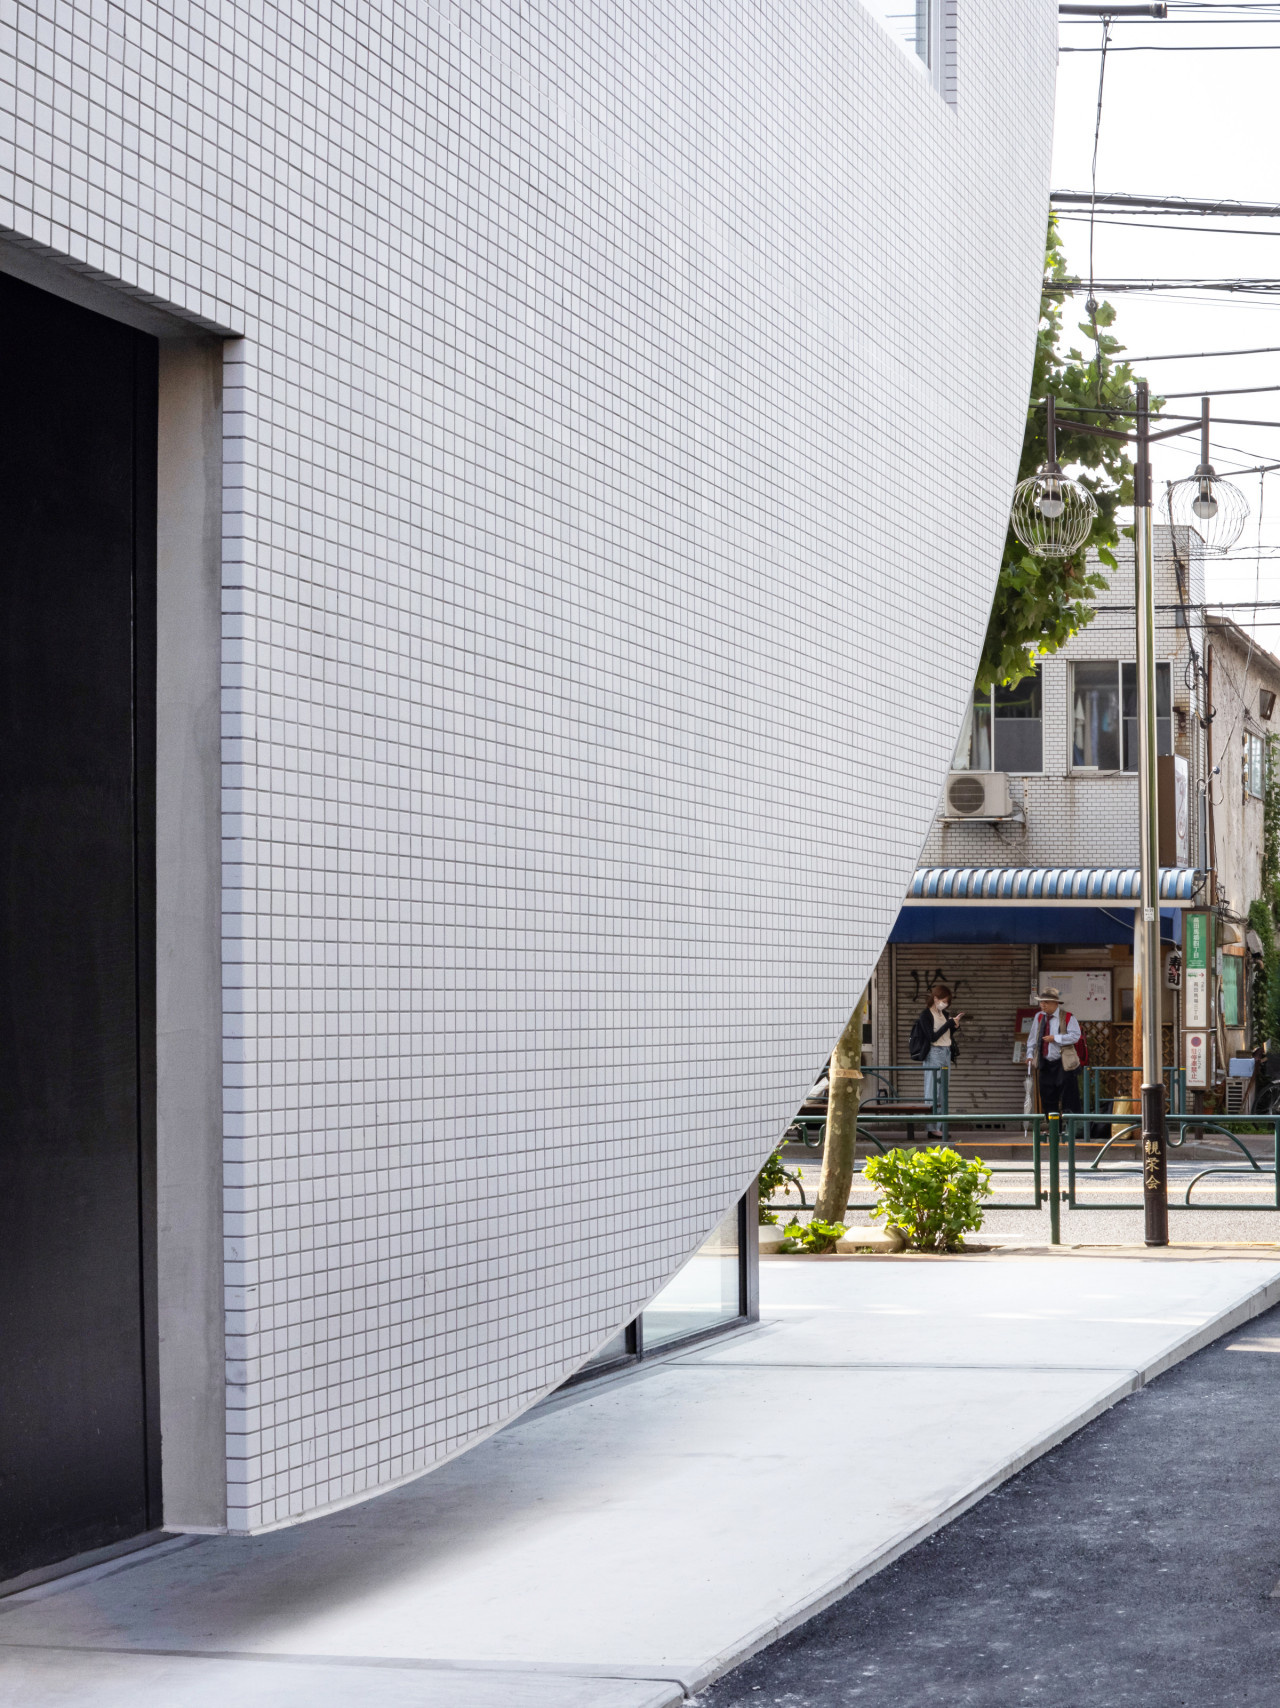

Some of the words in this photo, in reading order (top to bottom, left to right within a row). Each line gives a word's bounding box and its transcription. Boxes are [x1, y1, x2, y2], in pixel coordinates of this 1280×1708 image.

[1168, 955, 1182, 986] 寿司
[1144, 1139, 1161, 1190] 親栄会
